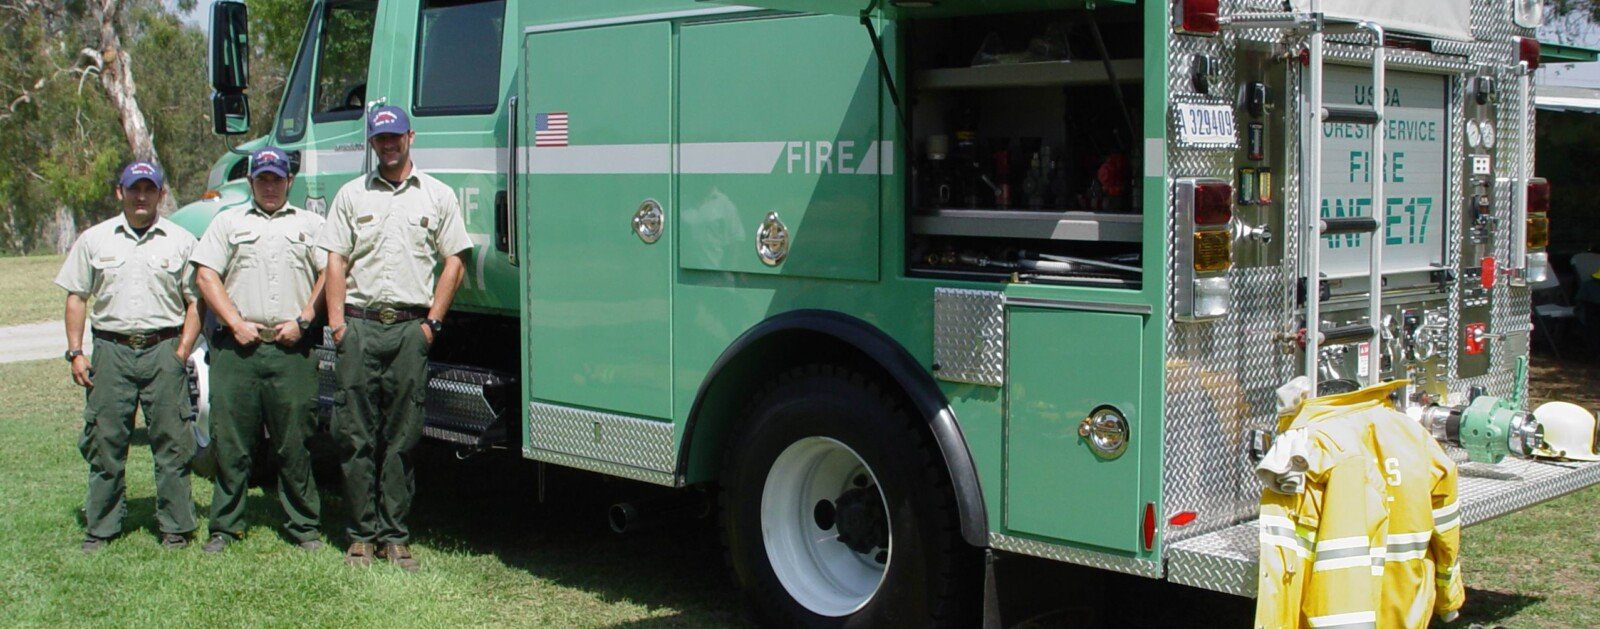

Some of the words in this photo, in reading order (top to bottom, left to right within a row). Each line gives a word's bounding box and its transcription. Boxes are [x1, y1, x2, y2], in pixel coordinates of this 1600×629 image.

[1190, 109, 1233, 136] 329409
[1322, 121, 1371, 139] OREST
[787, 140, 855, 174] FIRE
[1385, 197, 1433, 246] E17
